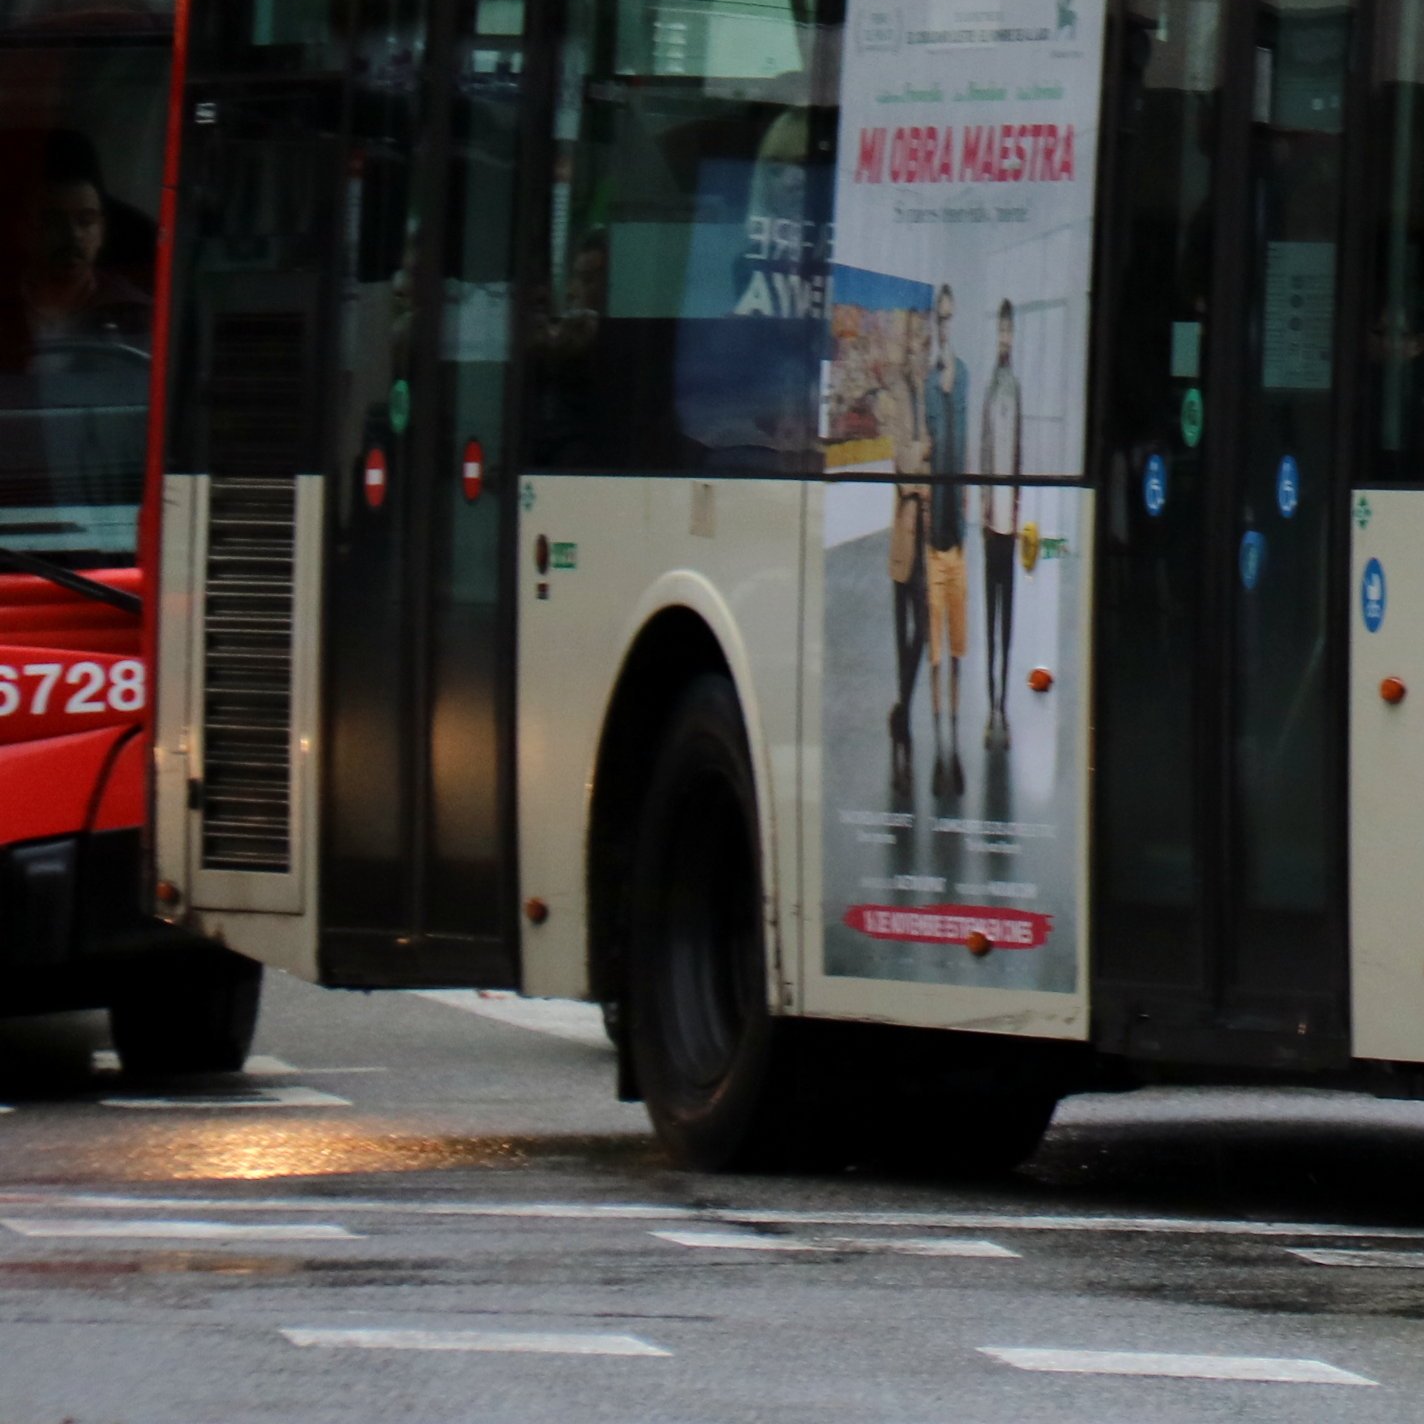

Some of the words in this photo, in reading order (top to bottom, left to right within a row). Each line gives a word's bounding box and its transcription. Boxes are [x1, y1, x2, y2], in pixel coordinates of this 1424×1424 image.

[855, 127, 886, 184] MI
[891, 126, 954, 184] OBRA
[958, 123, 1075, 183] MAESTRA
